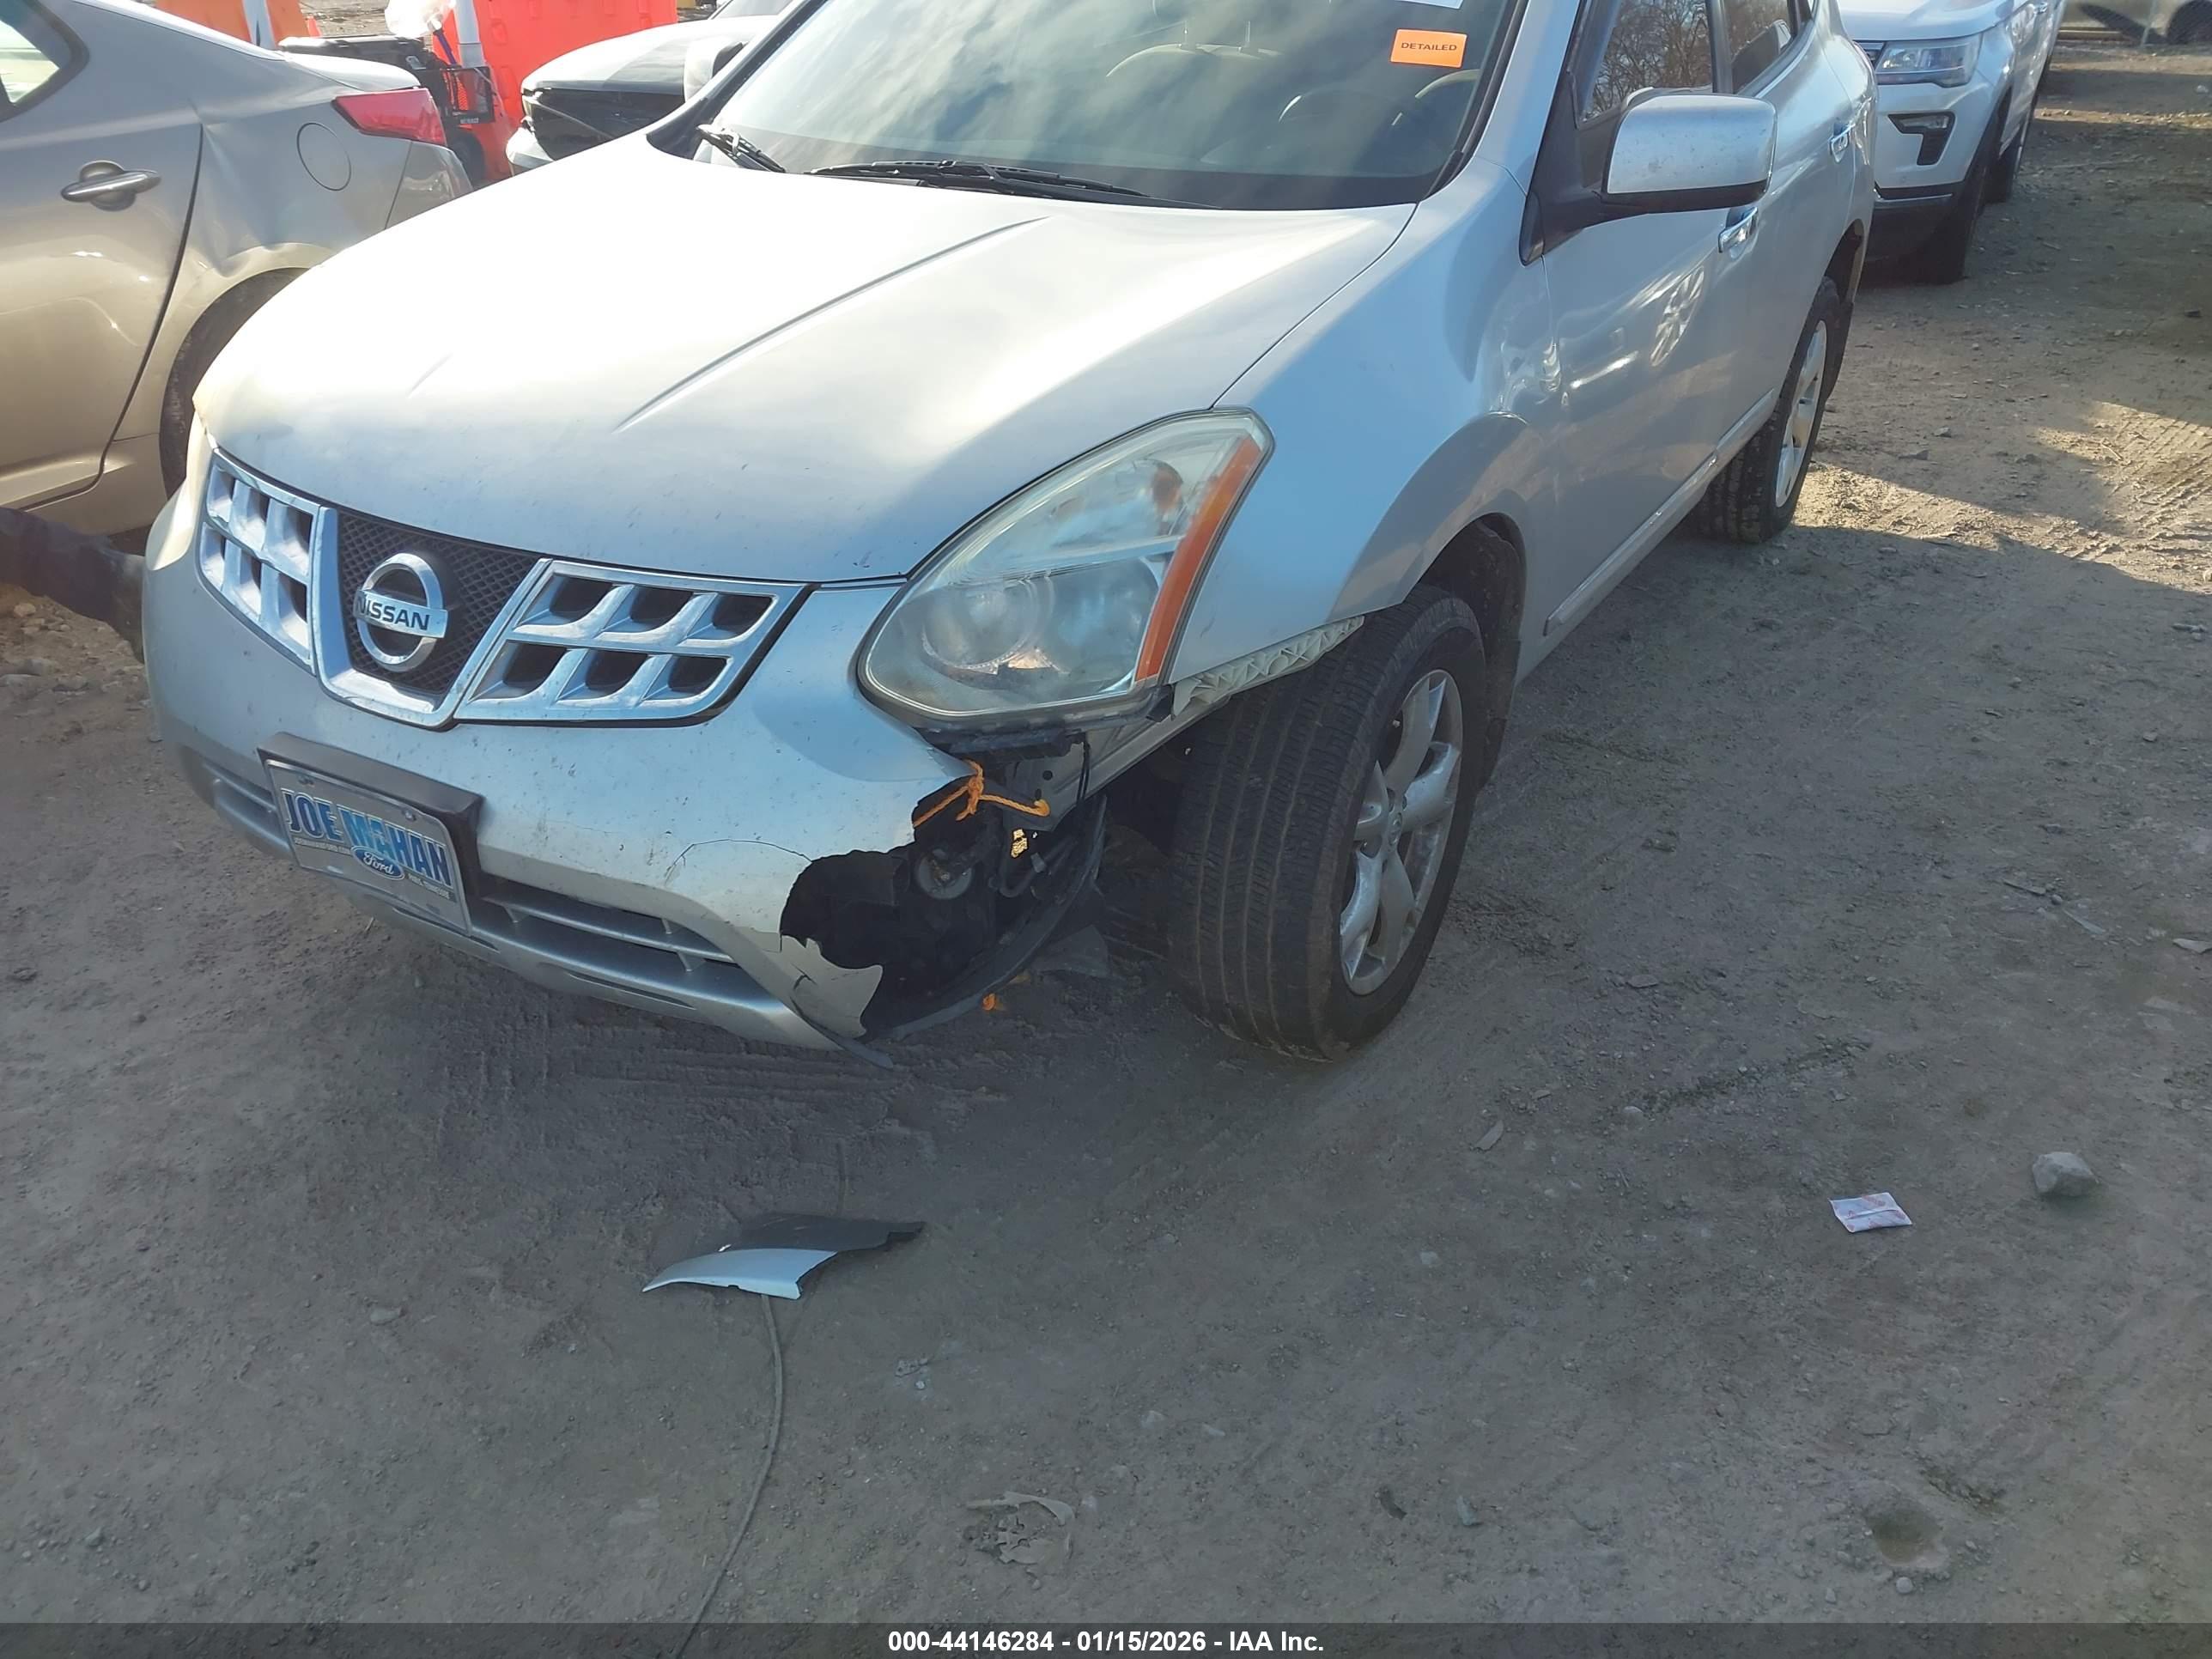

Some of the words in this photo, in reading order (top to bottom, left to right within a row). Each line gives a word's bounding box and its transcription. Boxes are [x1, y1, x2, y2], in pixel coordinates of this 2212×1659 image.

[1401, 42, 1457, 52] DETAILED
[355, 592, 430, 631] NISSAN
[281, 787, 344, 843] JOE
[362, 851, 395, 875] Ford
